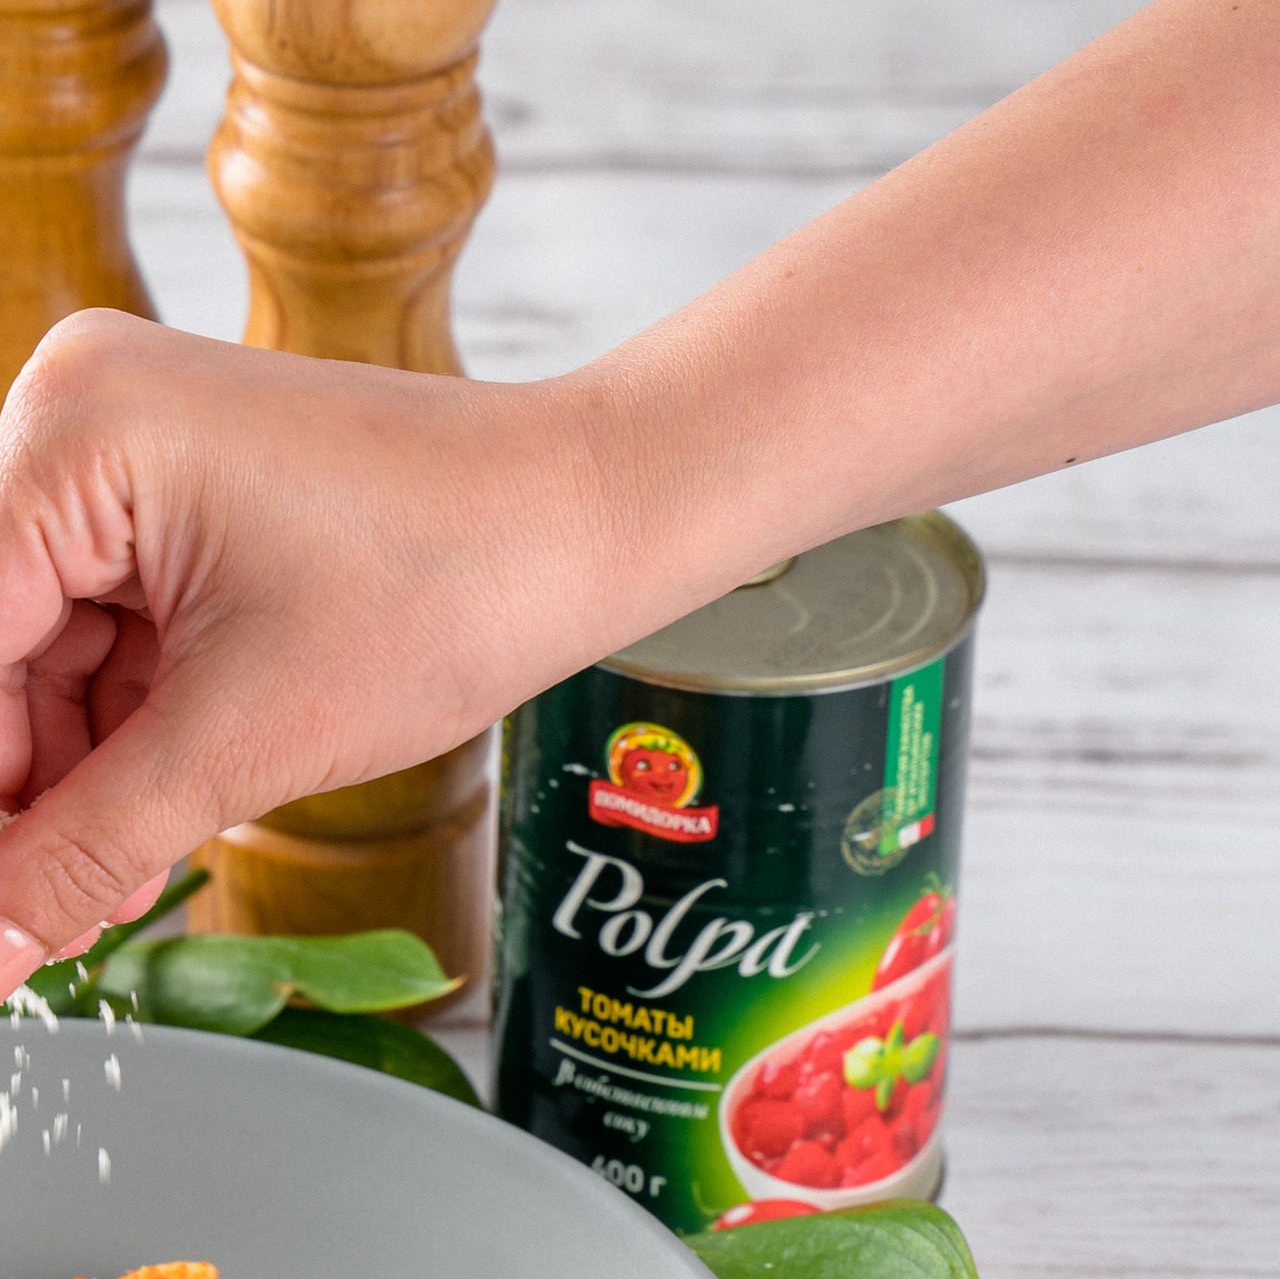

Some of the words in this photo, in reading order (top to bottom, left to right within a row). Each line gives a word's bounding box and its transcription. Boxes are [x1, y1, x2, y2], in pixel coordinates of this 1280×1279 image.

[593, 789, 712, 834] ПОМИДОРКА
[552, 839, 821, 999] Polpa
[554, 1005, 721, 1073] КУСОЧКАМИ
[578, 986, 694, 1040] ТОМАТЫ
[649, 1175, 667, 1197] г
